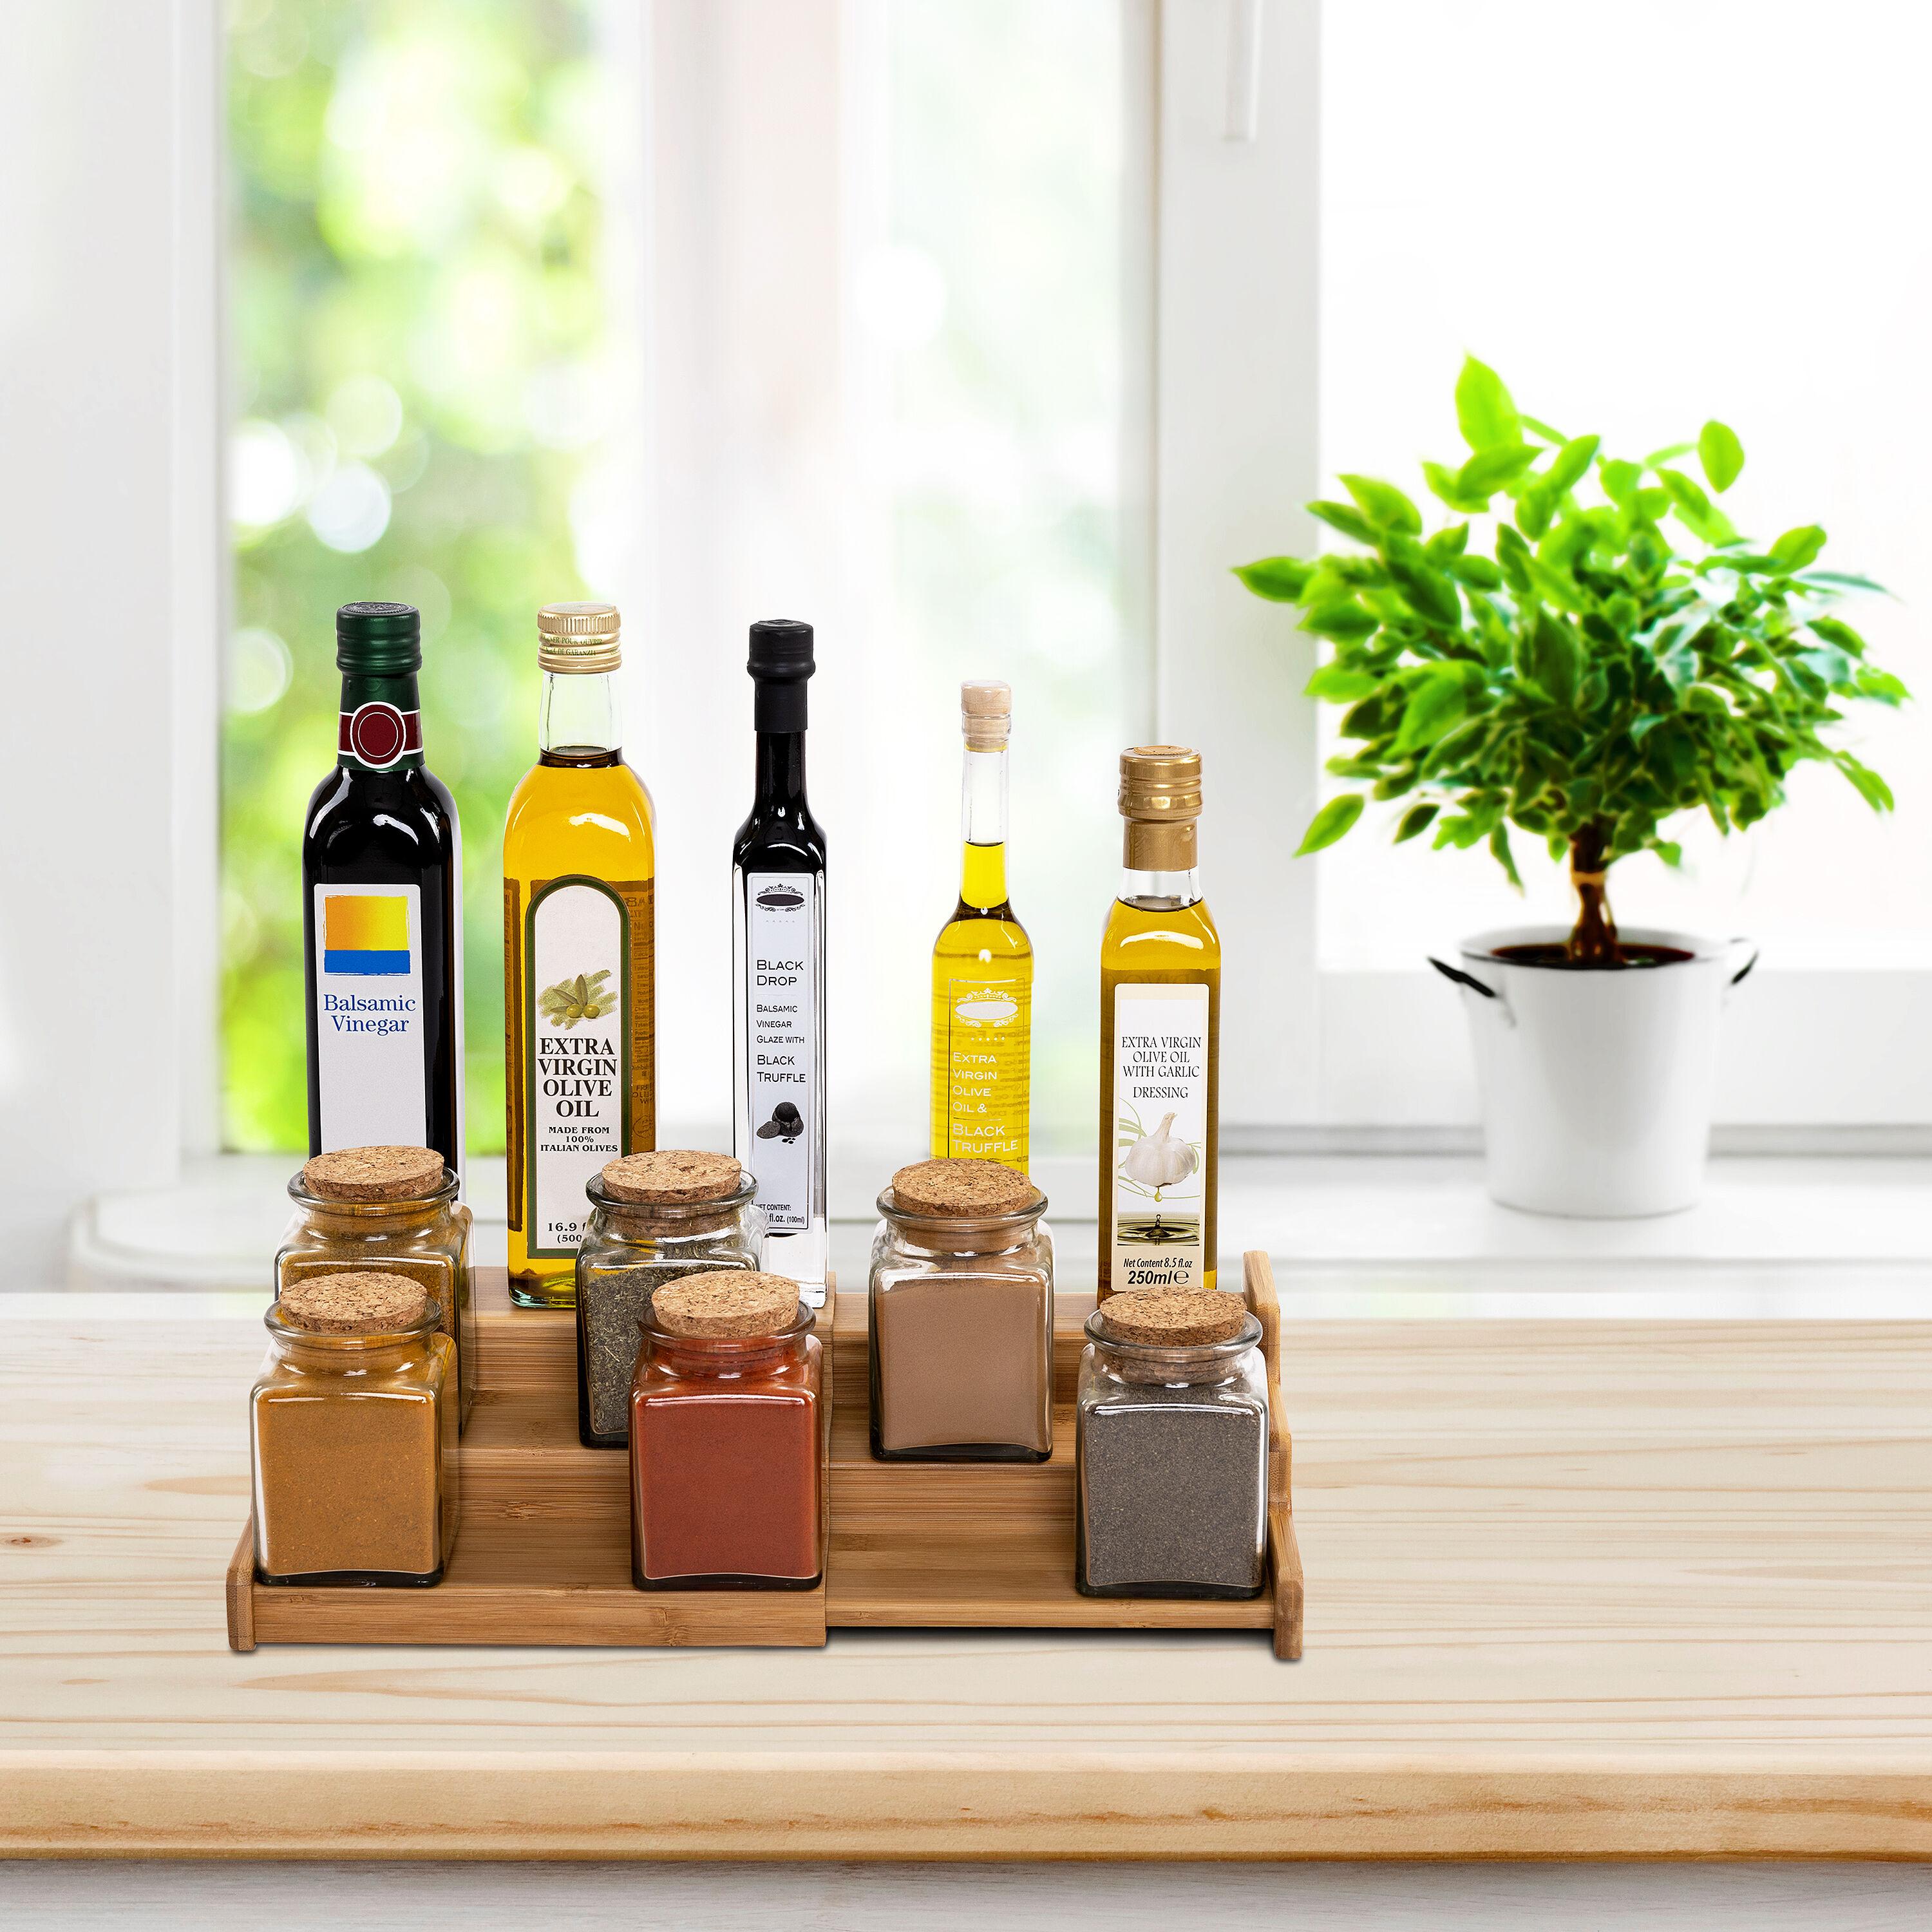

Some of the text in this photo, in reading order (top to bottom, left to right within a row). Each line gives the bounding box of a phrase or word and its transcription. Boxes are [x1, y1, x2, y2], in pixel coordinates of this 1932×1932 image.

[757, 960, 804, 971] BLACK
[757, 975, 797, 986] DROP
[323, 994, 416, 1012] Balsamic
[331, 1015, 410, 1036] Vinegar
[540, 1037, 615, 1055] EXTRA
[1122, 1037, 1202, 1048] EXTRA VIRGIN
[757, 1054, 795, 1065] BLACK
[953, 1052, 998, 1064] EXTRA
[1133, 1051, 1190, 1063] OLIVE OIL
[537, 1058, 618, 1076] VIRGIN
[1122, 1065, 1200, 1077] WITH GARLIC
[757, 1072, 806, 1083] TRUFFLE
[952, 1068, 998, 1080] VIRGIN
[543, 1079, 612, 1097] OLIVE
[952, 1085, 992, 1097] OLIVE
[1133, 1086, 1188, 1098] DRESSING
[556, 1100, 600, 1117] OIL
[952, 1101, 987, 1113] OIL &
[953, 1123, 1005, 1137] BLACK
[952, 1139, 1018, 1153] TRUFFLE
[548, 1222, 577, 1231] 16.9
[1123, 1258, 1136, 1267] Net
[1137, 1258, 1163, 1267] Content
[1164, 1257, 1177, 1267] 8.5
